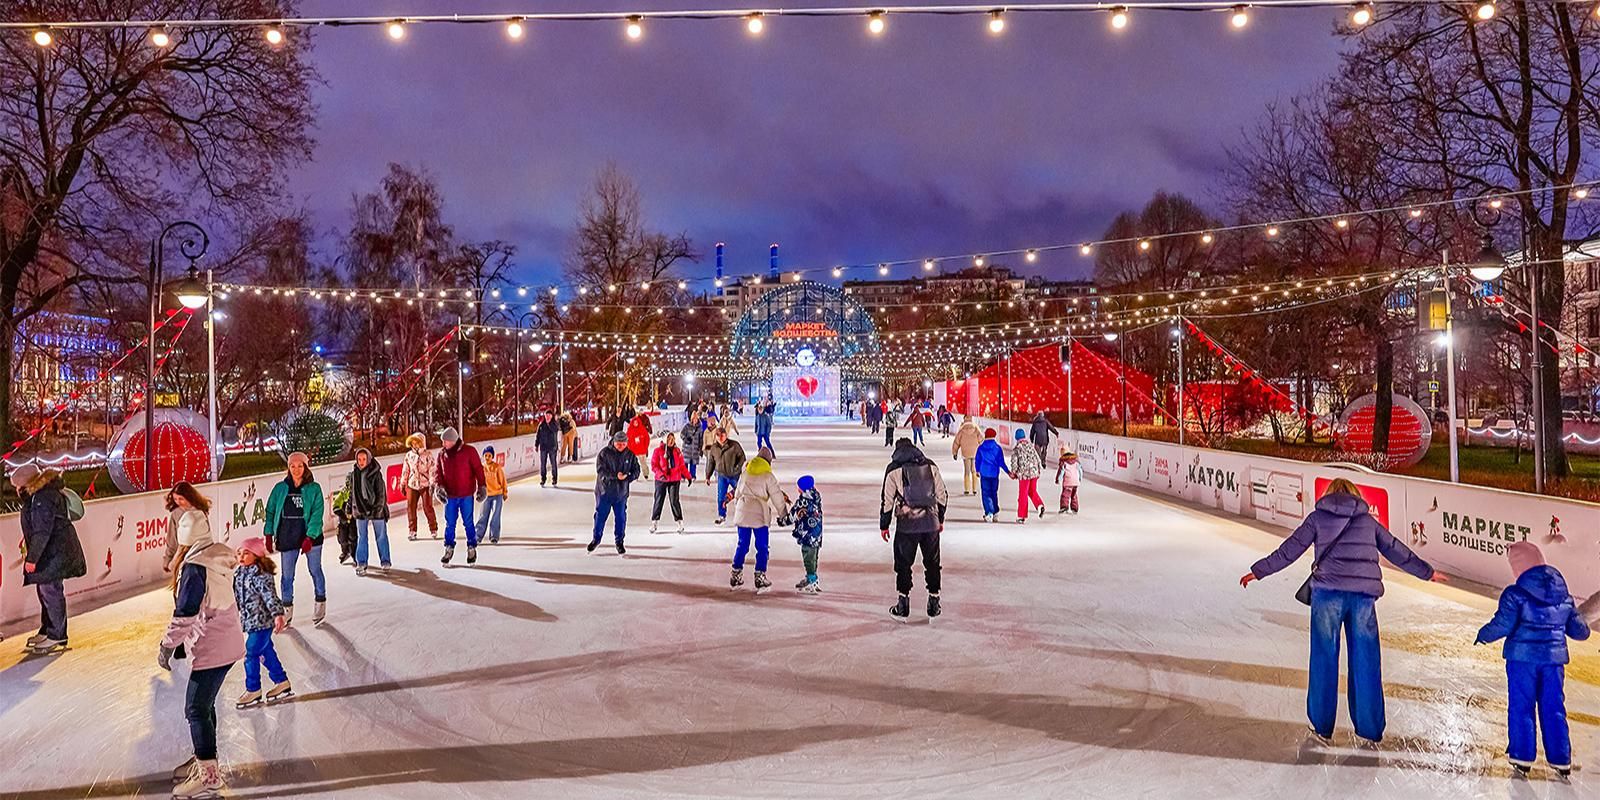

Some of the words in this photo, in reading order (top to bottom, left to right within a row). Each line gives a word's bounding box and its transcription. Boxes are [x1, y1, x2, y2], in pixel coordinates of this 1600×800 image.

[773, 330, 838, 338] ВОЛШЕБСТВА
[785, 322, 826, 330] МАРКЕТ
[1188, 464, 1236, 493] КАТОК
[136, 516, 168, 539] ЗИМ
[1442, 511, 1531, 543] МАРКЕТ
[136, 542, 142, 552] В
[1443, 532, 1510, 557] ВОЛШЕБСТ
